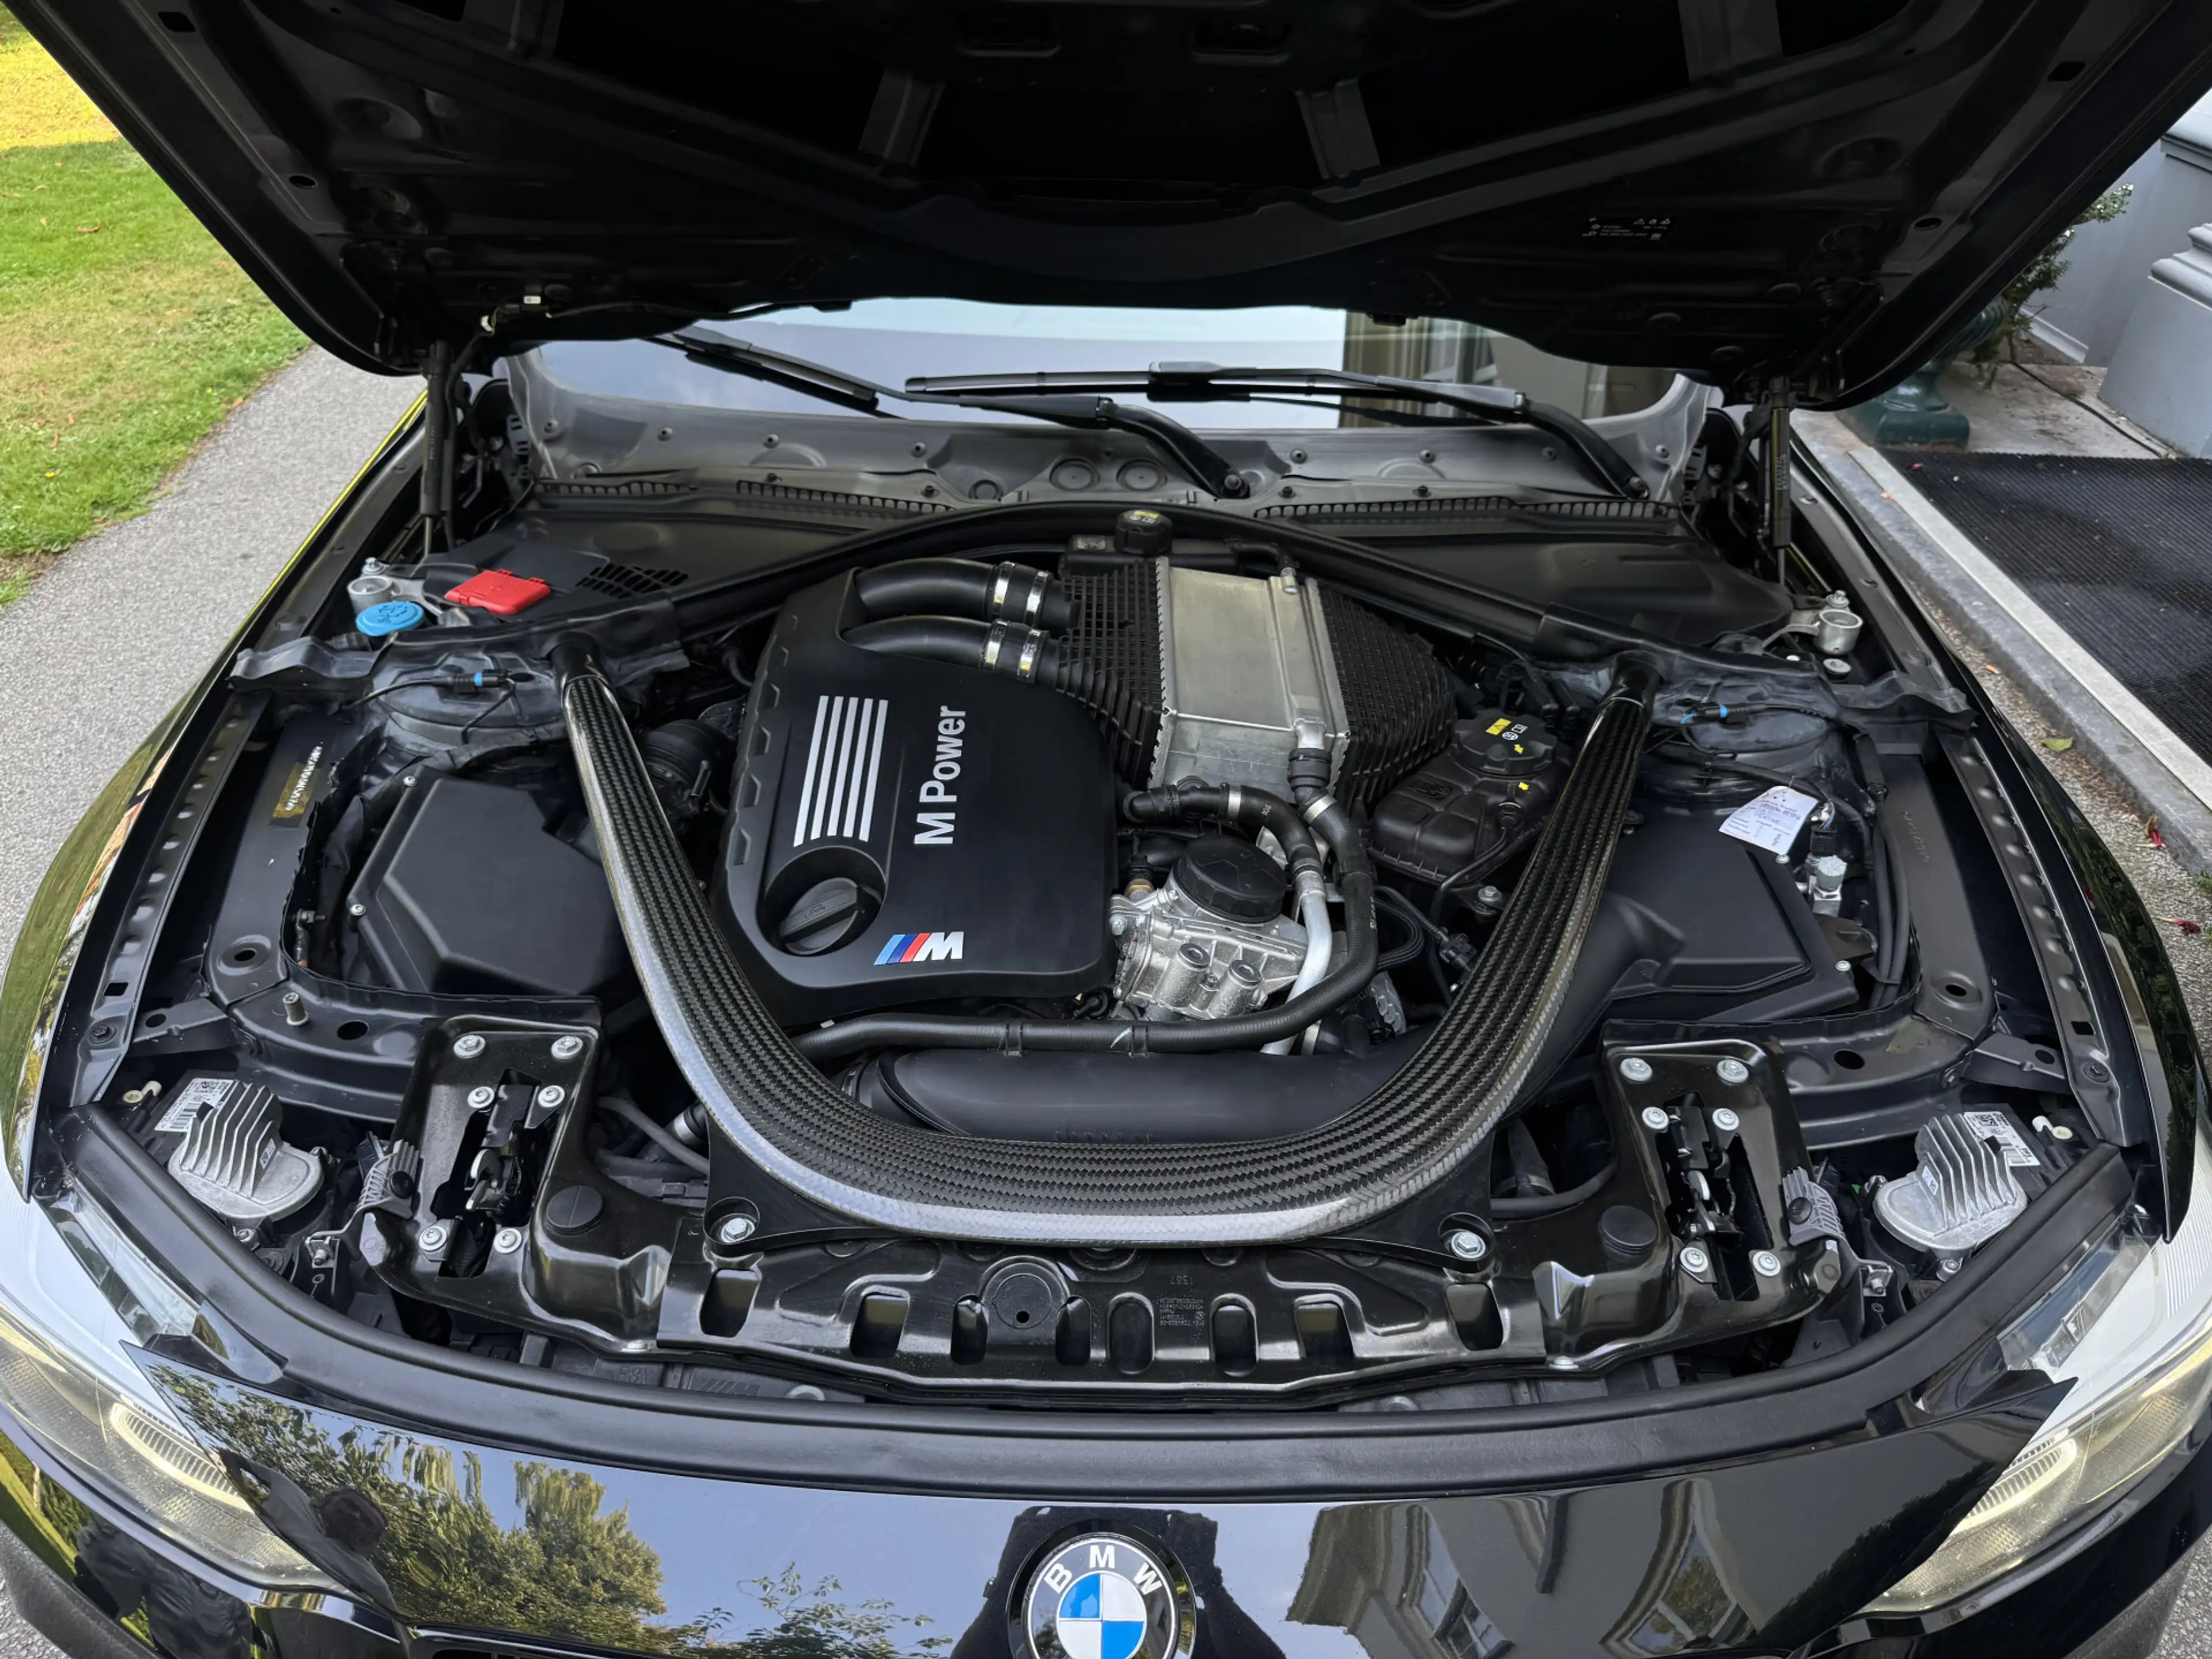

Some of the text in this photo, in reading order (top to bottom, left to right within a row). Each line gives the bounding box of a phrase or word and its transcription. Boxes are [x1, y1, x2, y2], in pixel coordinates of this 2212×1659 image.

[914, 706, 966, 844] M Power
[1044, 1544, 1162, 1595] BMW
